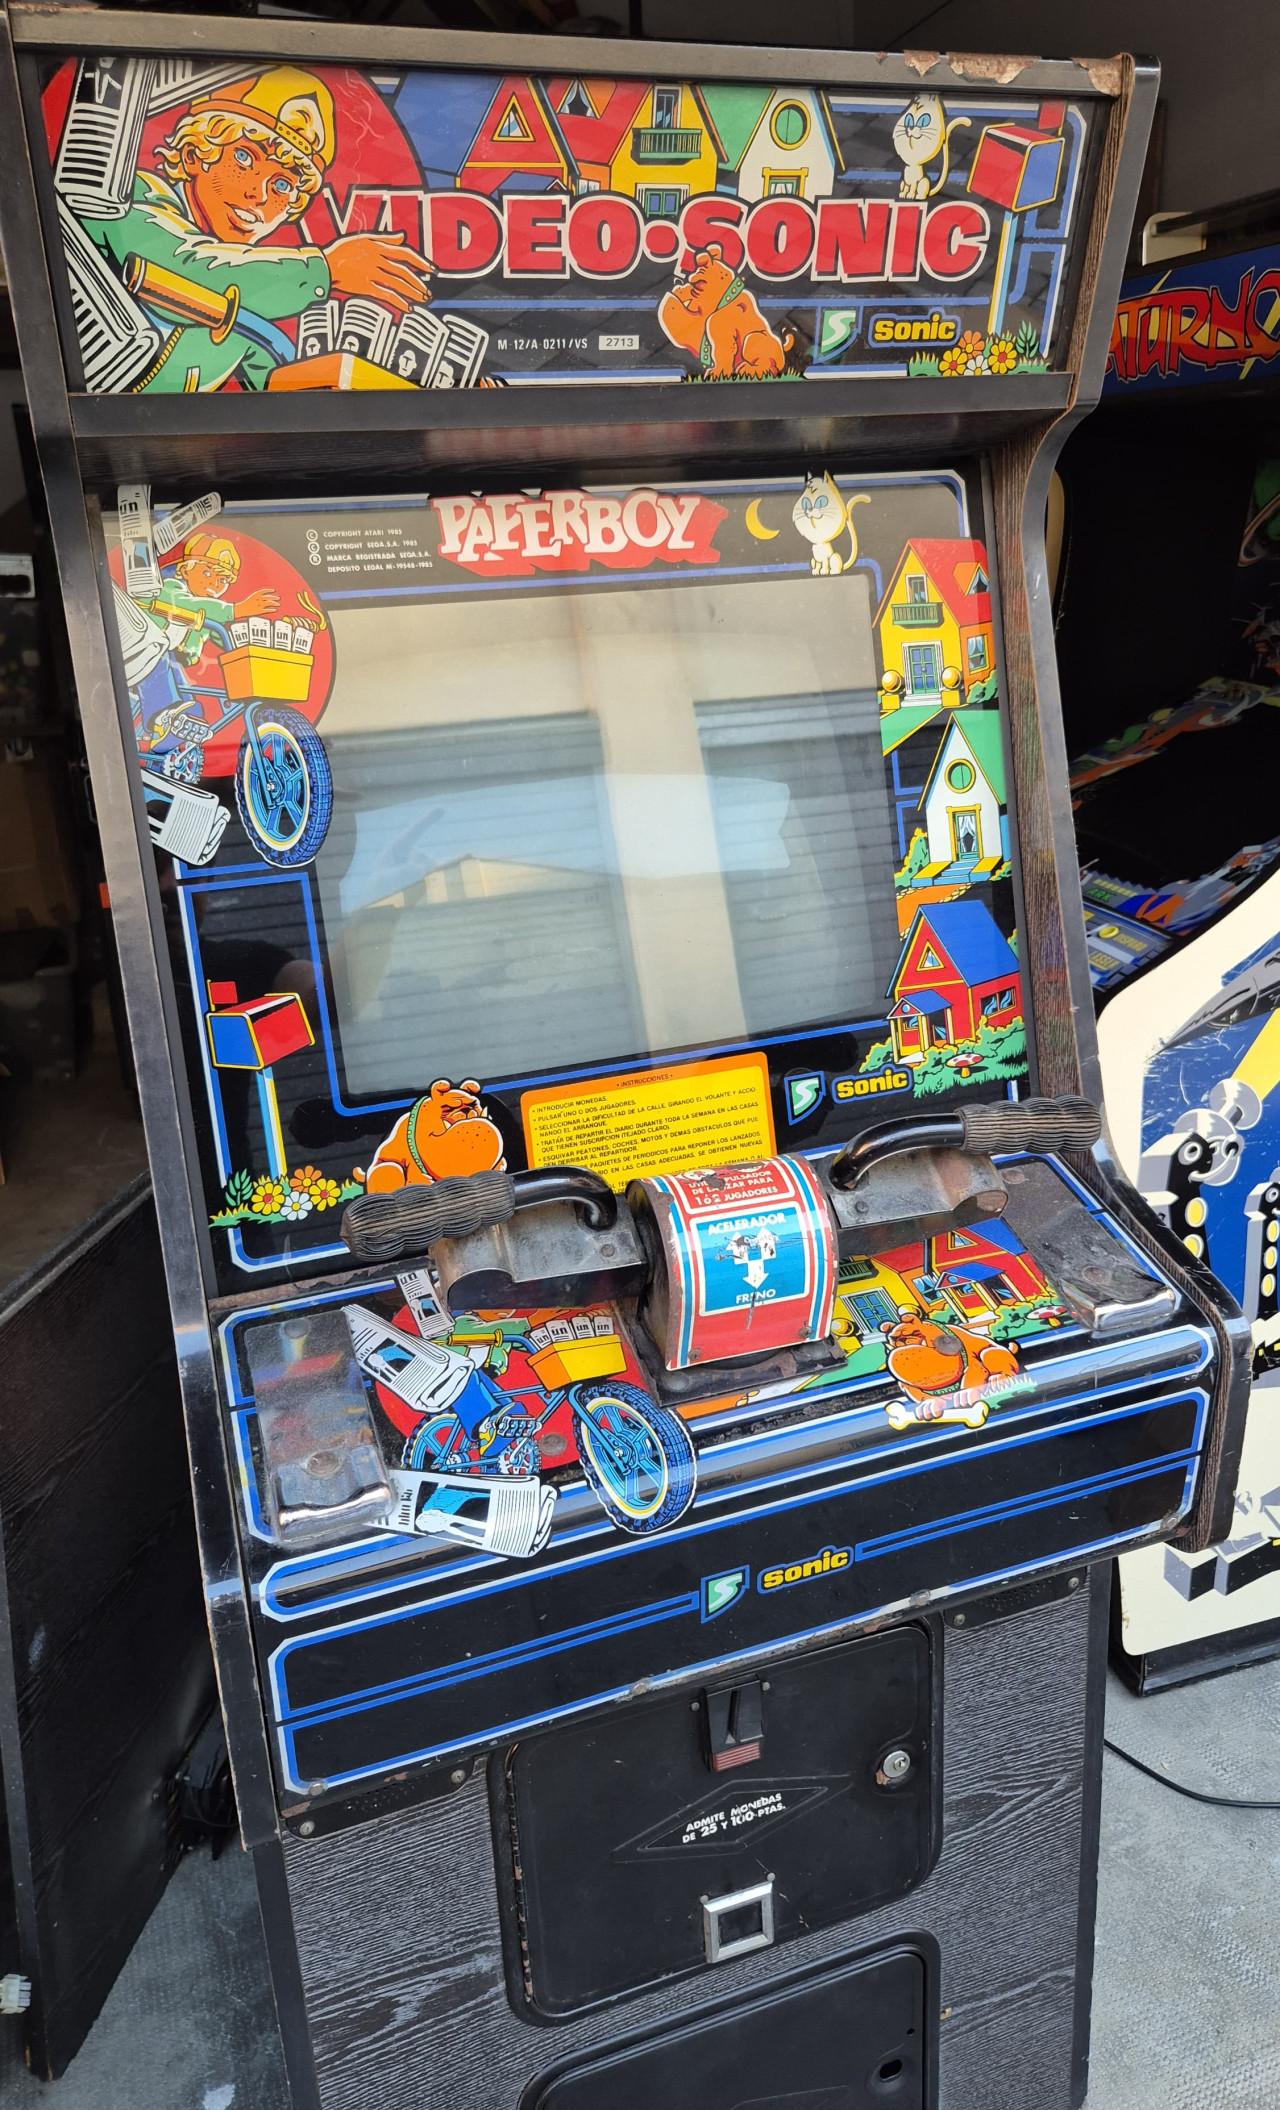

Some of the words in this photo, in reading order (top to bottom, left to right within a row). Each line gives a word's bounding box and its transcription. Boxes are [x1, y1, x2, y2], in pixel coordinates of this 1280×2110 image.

[874, 313, 955, 341] sonic
[605, 337, 634, 347] 2713
[323, 530, 361, 538] COPYRIGHT
[364, 529, 384, 537] ATARI
[387, 528, 403, 536] 1985
[432, 489, 701, 563] PAPERBOY
[324, 542, 363, 551] COPYRIGHT
[326, 554, 352, 562] MARCA
[355, 552, 396, 561] REGISTRADA
[327, 565, 361, 573] DEPOSITO
[621, 1073, 669, 1087] INSTRUCCIONES
[836, 1068, 908, 1099] sonic
[536, 1102, 574, 1113] INTRODUCIR
[539, 1118, 581, 1131] SELECCIONAR
[592, 1110, 626, 1121] DIFICULTAD
[668, 1098, 695, 1107] GIRANDO
[705, 1091, 731, 1100] VOLANTE
[563, 1110, 577, 1118] UNO
[585, 1106, 598, 1114] DOS
[575, 1130, 604, 1140] REPARTIR
[614, 1124, 634, 1133] DIARIO
[635, 1119, 663, 1129] DURANTE
[691, 1109, 716, 1118] SEMANA
[740, 1101, 759, 1109] CASAS
[540, 1129, 562, 1137] NANDO
[543, 1152, 575, 1162] ESQUIVAR
[641, 1134, 663, 1143] MOTOS
[670, 1129, 691, 1138] DEMAS
[692, 1121, 732, 1133] OBSTACULOS
[733, 1118, 745, 1126] QUE
[556, 1142, 578, 1150] TIENEN
[580, 1133, 620, 1146] SUSCRIPCION
[590, 1157, 621, 1168] PAQUETES
[632, 1149, 669, 1160] PERIODICOS
[670, 1145, 686, 1153] PARA
[687, 1140, 716, 1149] REPONER
[730, 1131, 761, 1141] LANZADOS
[636, 1159, 656, 1168] CASAS
[708, 1144, 737, 1155] OBTIENEN
[740, 1139, 763, 1148] NUEVAS
[558, 1155, 588, 1166] DERRIBAR
[724, 1170, 773, 1182] PULSADOR
[692, 1187, 704, 1195] DE
[747, 1176, 774, 1186] PARA
[724, 1185, 779, 1201] JUGADORES
[707, 1211, 787, 1236] ACELERADOR
[763, 1550, 848, 1589] sonic
[686, 1811, 725, 1832] ADMITE
[730, 1793, 782, 1816] MONEDAS
[682, 1832, 696, 1844] DE
[700, 1822, 718, 1837] 25
[720, 1820, 728, 1830] Y
